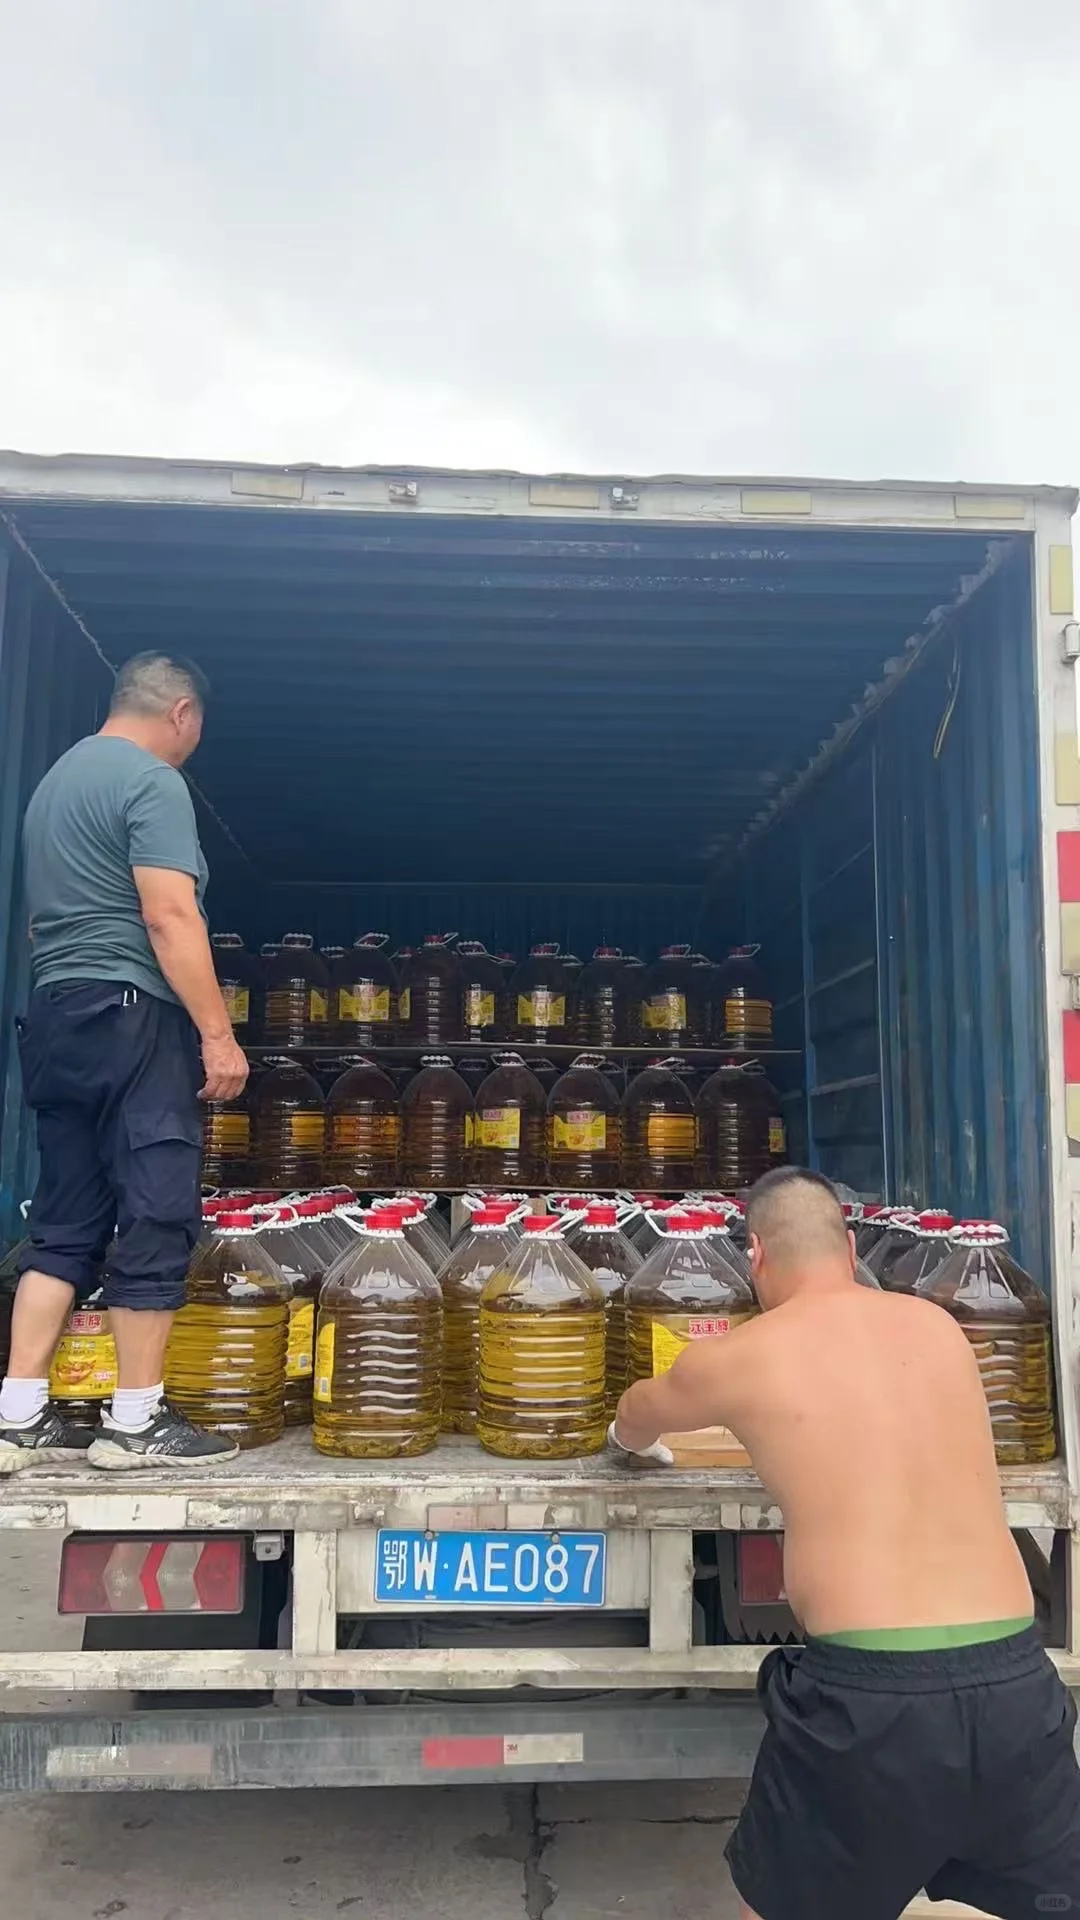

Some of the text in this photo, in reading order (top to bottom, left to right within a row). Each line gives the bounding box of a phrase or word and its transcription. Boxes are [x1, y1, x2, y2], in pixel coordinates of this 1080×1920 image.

[689, 1318, 728, 1335] 元宝牌
[383, 1539, 599, 1594] 鄂W·AE087
